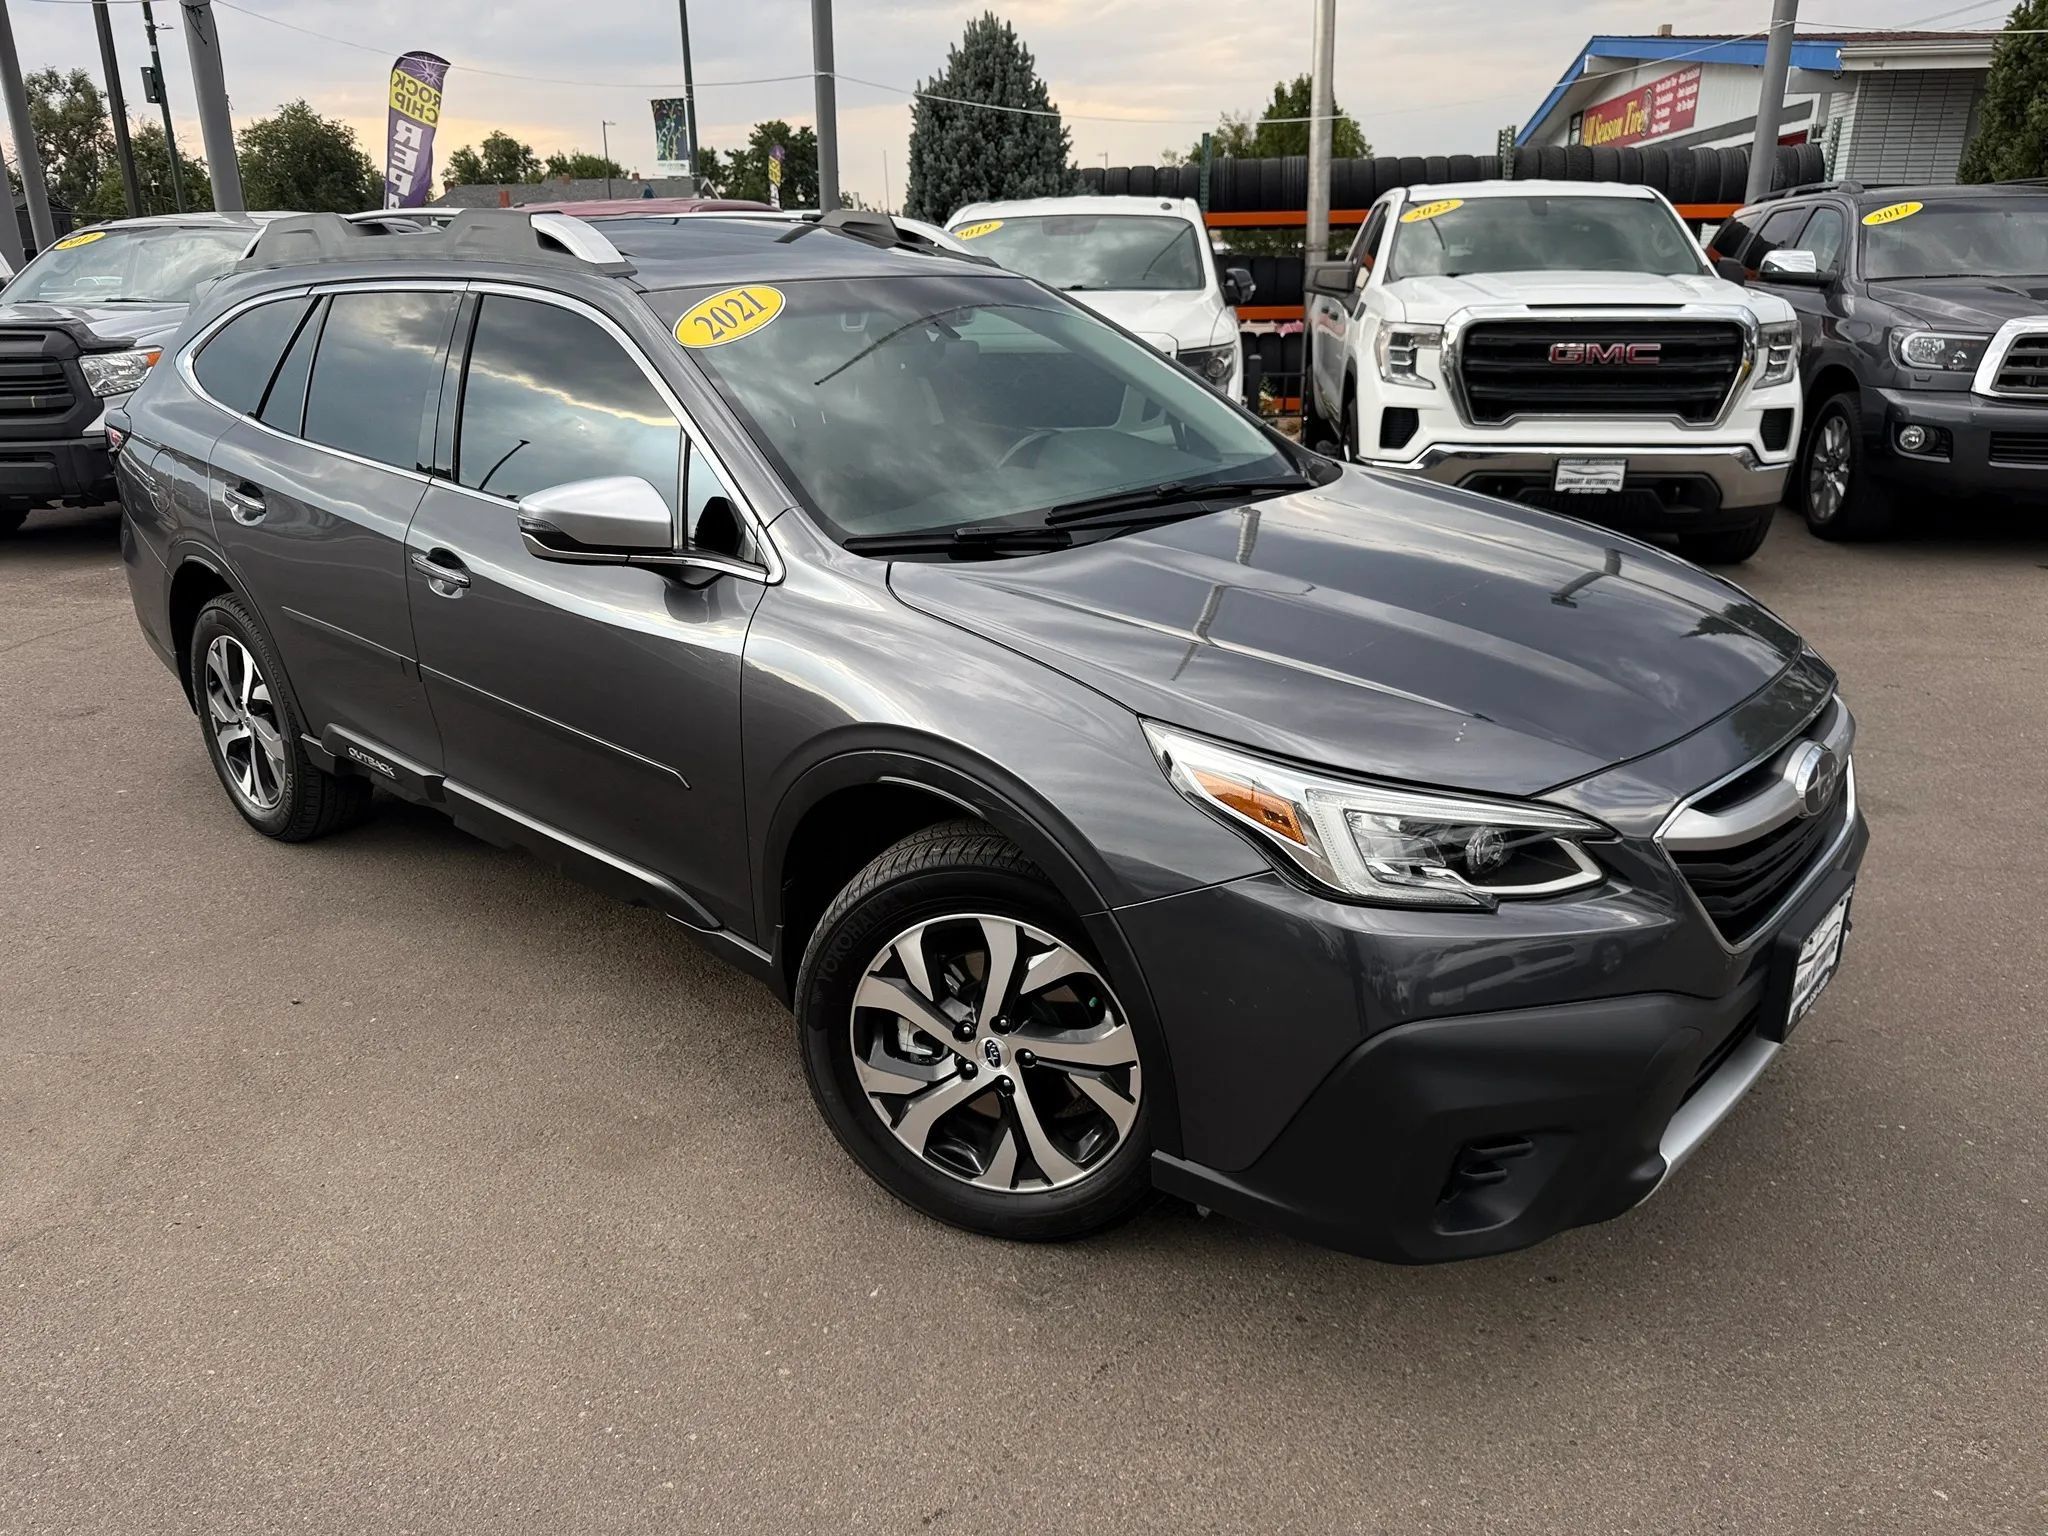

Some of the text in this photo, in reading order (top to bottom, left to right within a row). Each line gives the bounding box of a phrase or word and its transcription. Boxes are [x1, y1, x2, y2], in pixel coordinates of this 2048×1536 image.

[1874, 203, 1909, 223] 2017
[693, 290, 769, 340] 2021
[1549, 343, 1661, 365] GMC
[348, 747, 396, 777] OUTBACK
